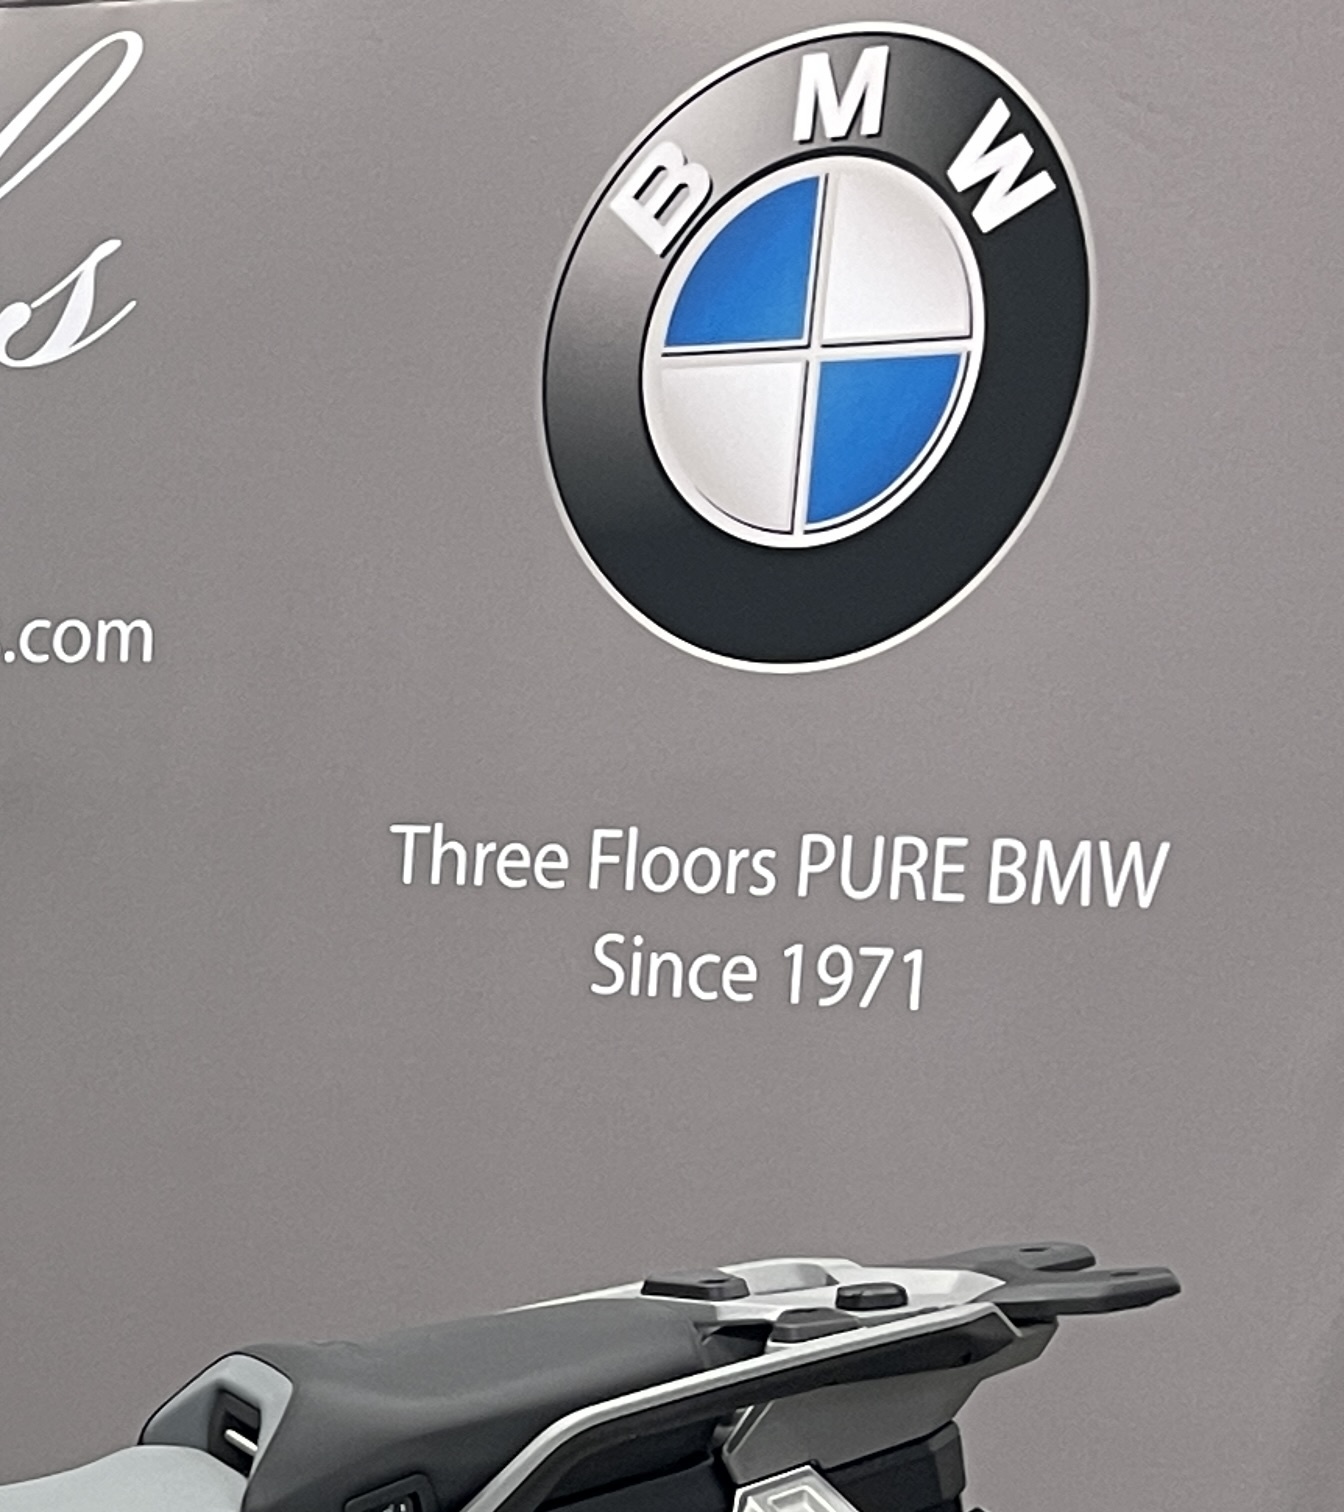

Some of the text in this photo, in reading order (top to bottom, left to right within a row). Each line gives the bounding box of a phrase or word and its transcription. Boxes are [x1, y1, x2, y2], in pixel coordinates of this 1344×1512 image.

[611, 45, 1056, 256] BMW
[388, 822, 1171, 910] Three Floors PURE BMW
[589, 932, 924, 1012] Since 1971
